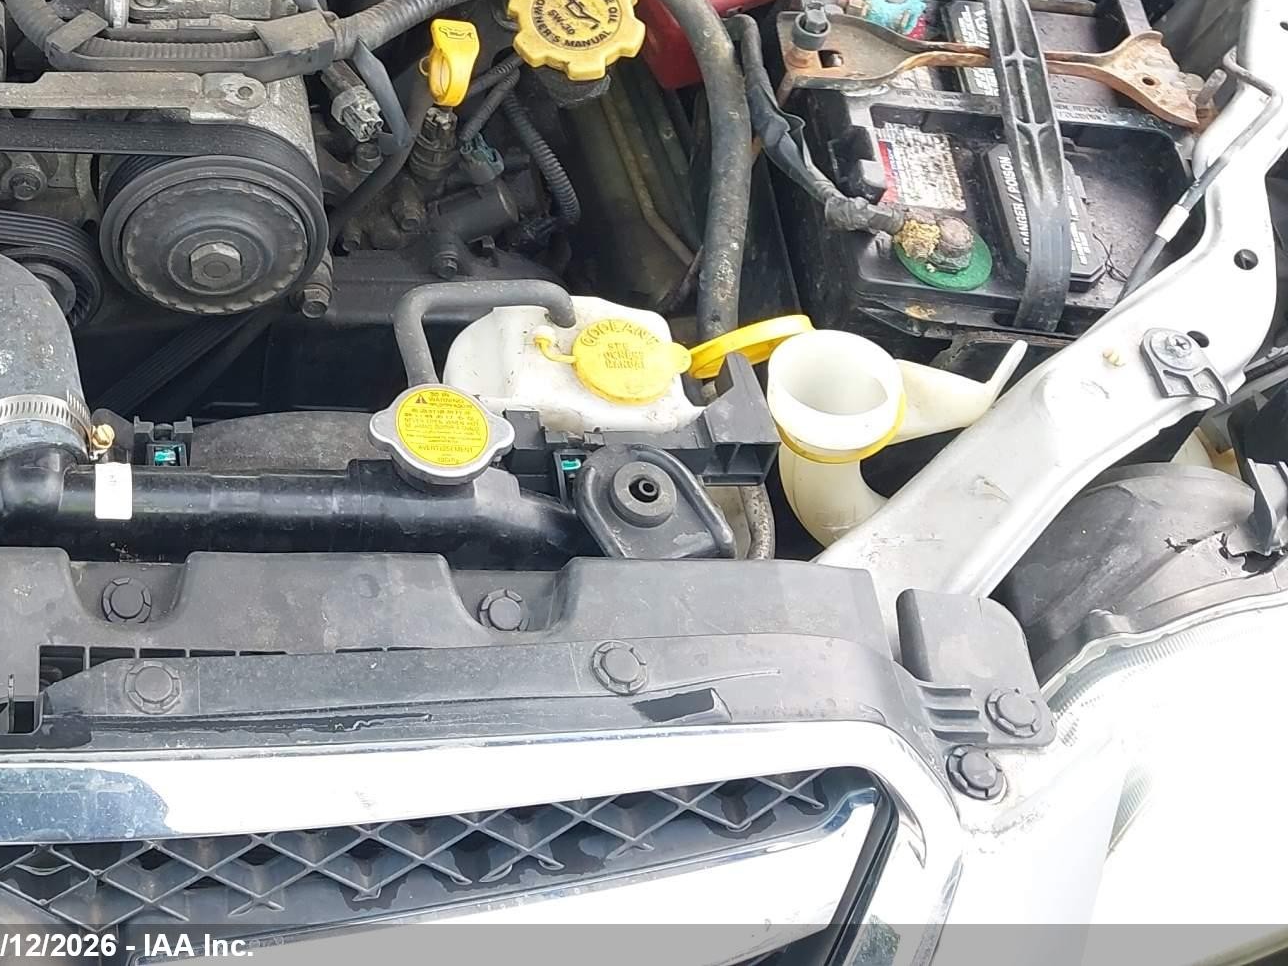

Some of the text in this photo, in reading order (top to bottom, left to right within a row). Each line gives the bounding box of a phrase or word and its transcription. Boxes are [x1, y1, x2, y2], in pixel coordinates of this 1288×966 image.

[547, 9, 576, 36] 5W-30
[607, 7, 619, 24] OIL
[563, 30, 612, 48] MANUAL
[580, 320, 660, 347] COOLANT
